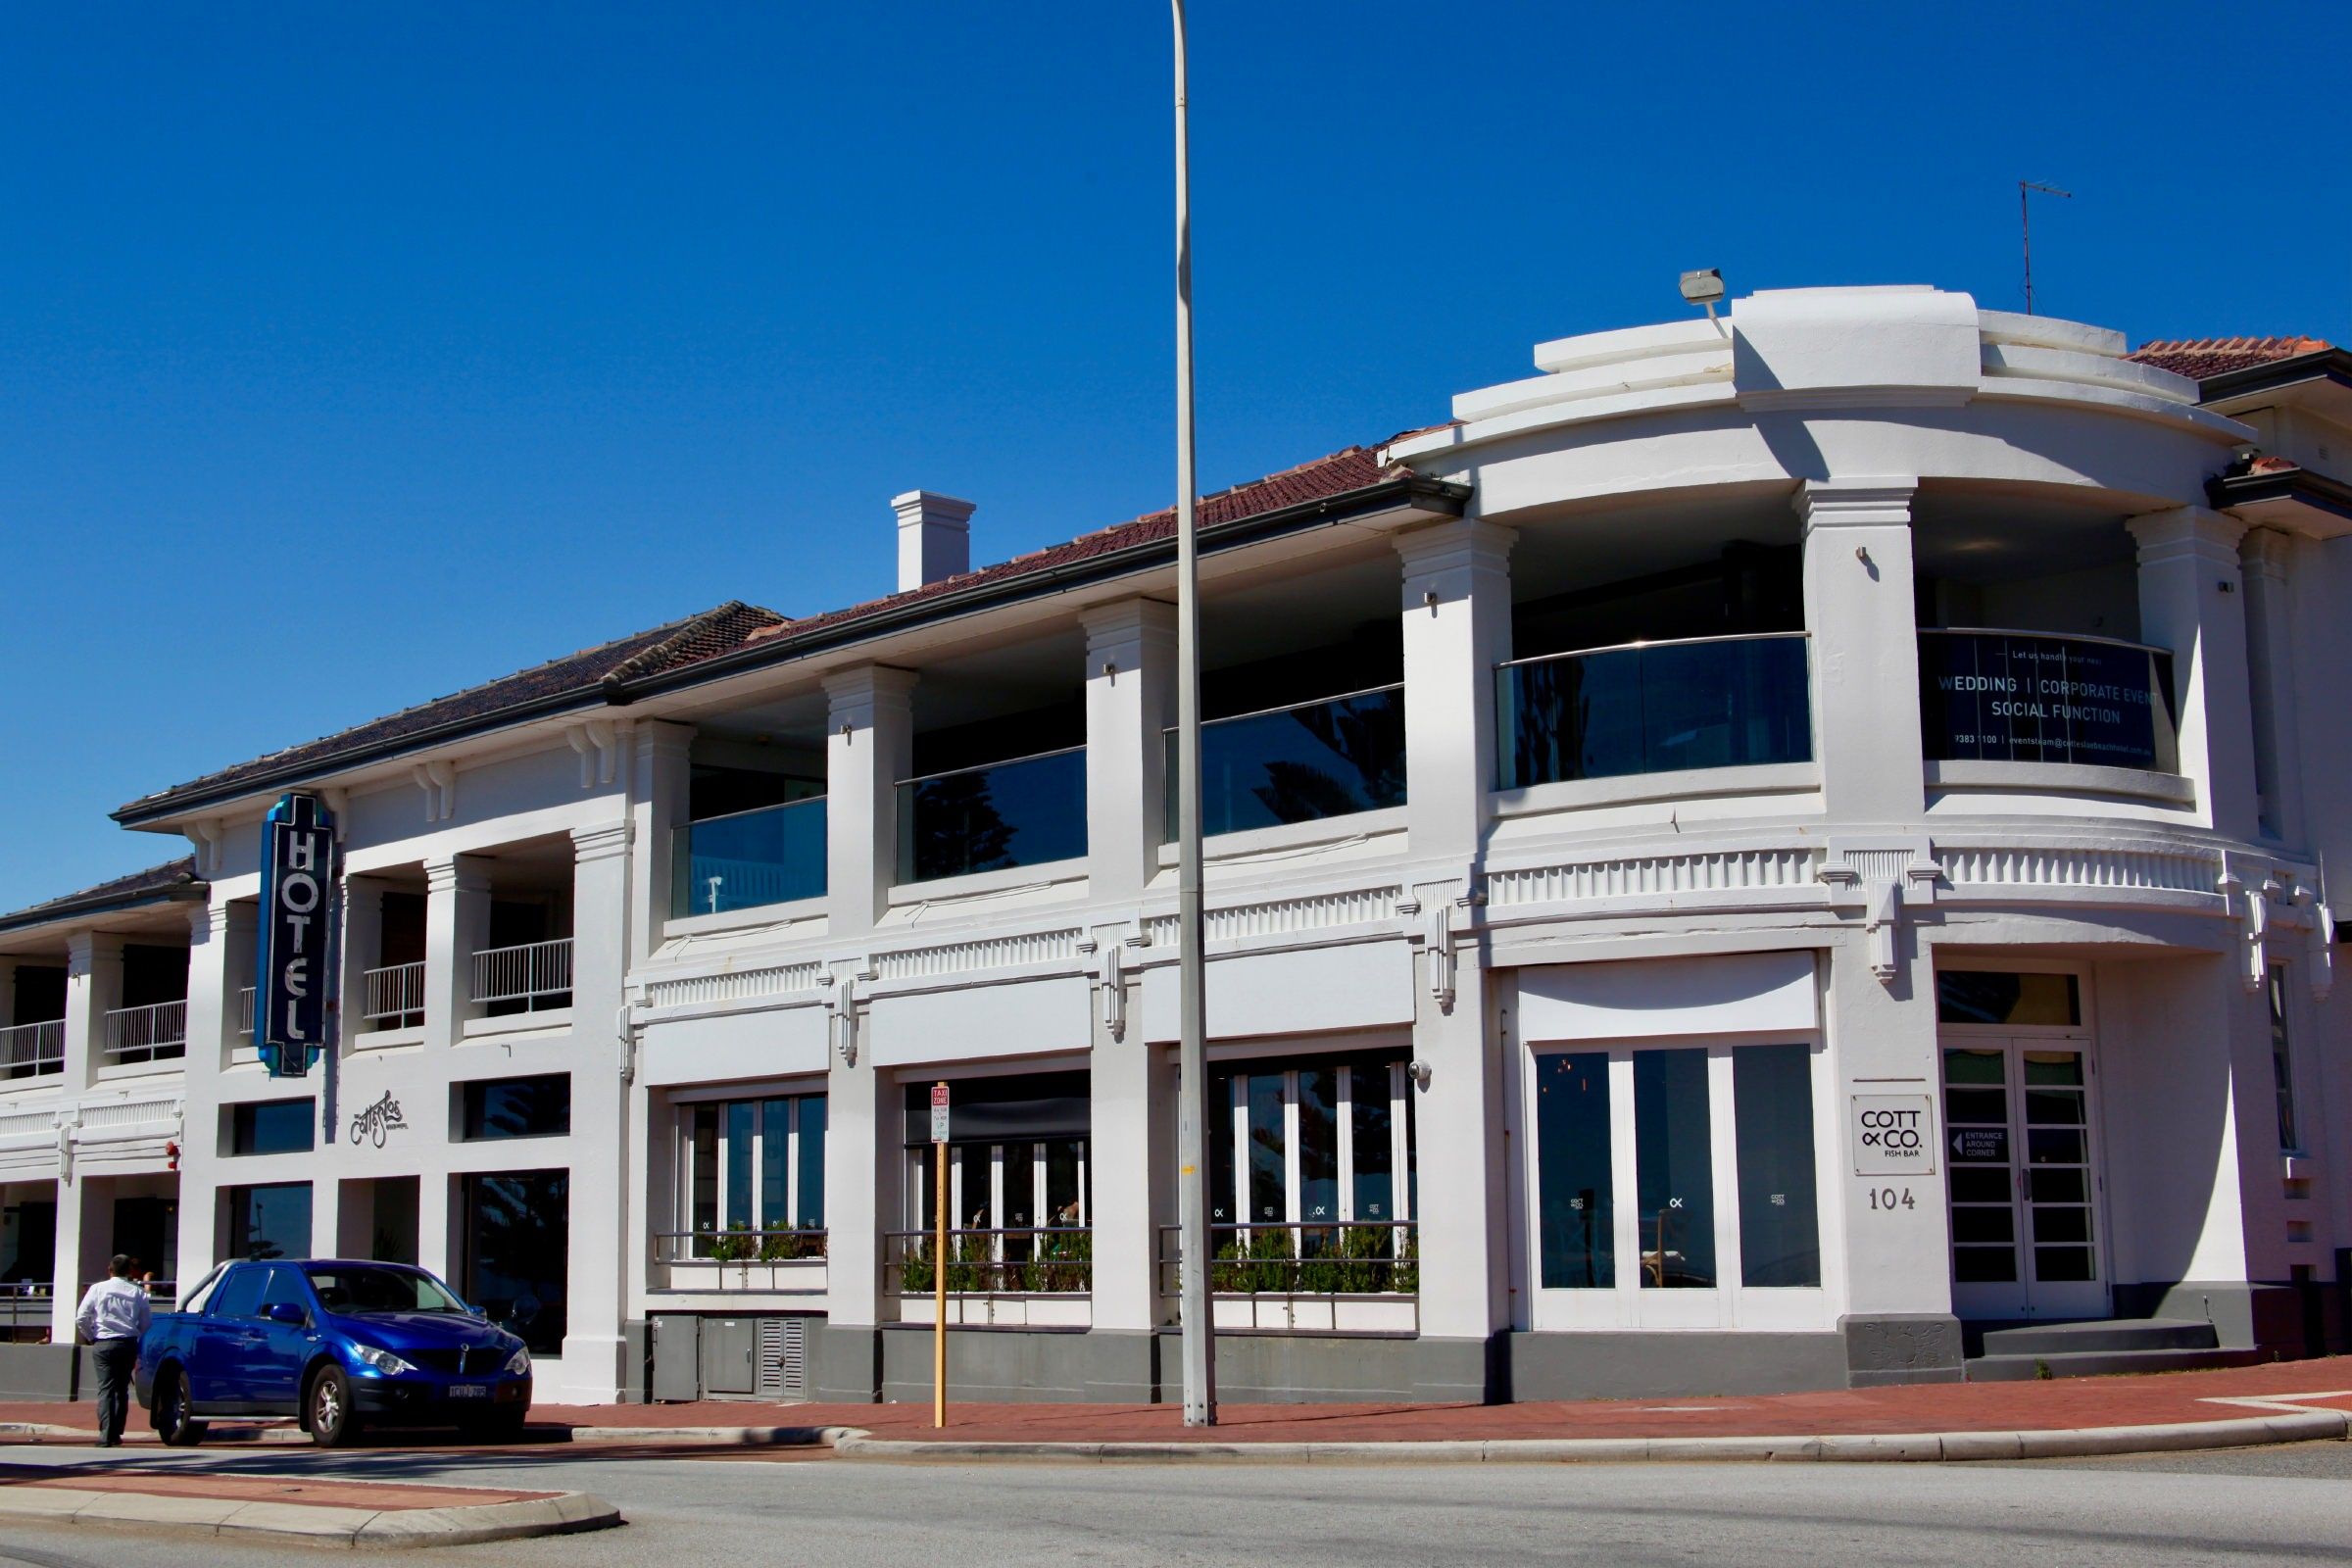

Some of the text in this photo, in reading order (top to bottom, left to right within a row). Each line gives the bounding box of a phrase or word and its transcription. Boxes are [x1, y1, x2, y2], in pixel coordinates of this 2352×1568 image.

[2013, 650, 2028, 660] Let
[1938, 675, 2017, 692] WEDDING
[2040, 679, 2121, 702] CORPORATE
[1991, 701, 2121, 724] SOCIAL FUNCTION
[281, 830, 319, 1041] HOTEL
[1861, 1110, 1921, 1128] COTT
[1966, 1140, 1995, 1149] AROUND
[1869, 1188, 1915, 1210] 104
